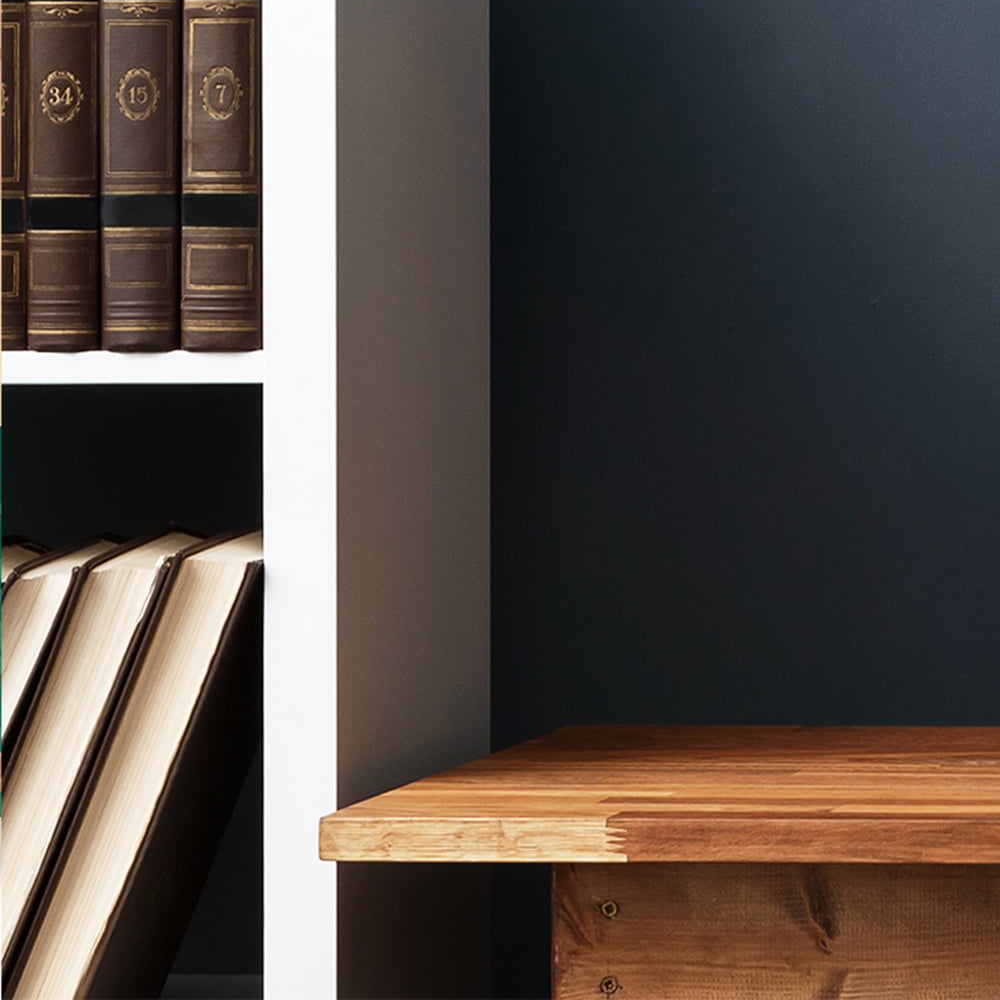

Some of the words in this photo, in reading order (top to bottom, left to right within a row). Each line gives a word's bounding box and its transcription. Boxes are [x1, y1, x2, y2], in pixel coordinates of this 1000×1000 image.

[49, 87, 73, 105] 34
[128, 86, 147, 103] 15
[216, 84, 227, 103] 7
